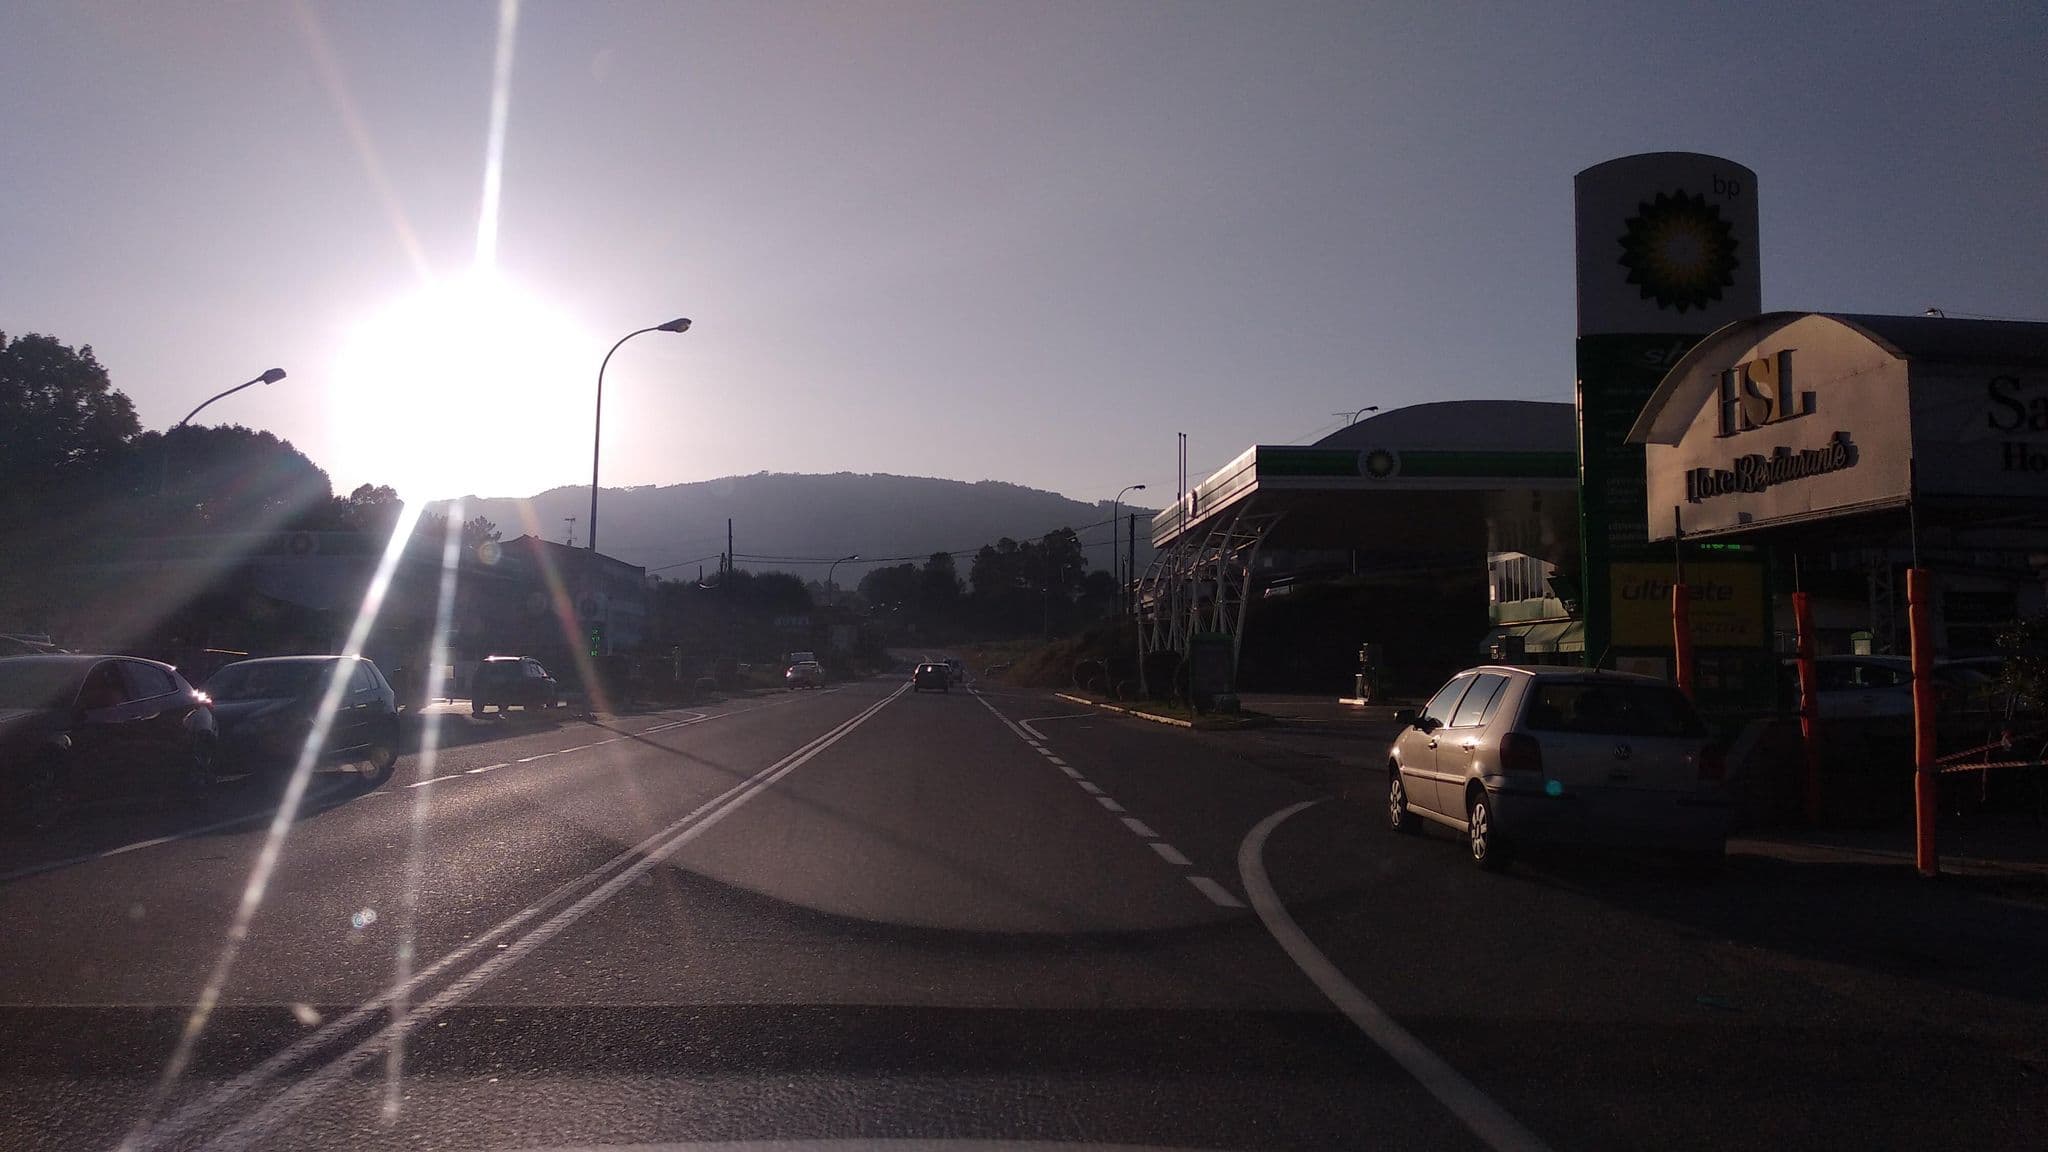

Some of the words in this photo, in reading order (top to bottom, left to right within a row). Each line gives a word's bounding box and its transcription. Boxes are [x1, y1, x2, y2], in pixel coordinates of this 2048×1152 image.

[1712, 174, 1740, 200] bp
[1712, 348, 1816, 438] HSL
[1685, 459, 1738, 504] Hotel
[1737, 433, 1856, 492] Restaurante
[1622, 579, 1734, 601] ultiate
